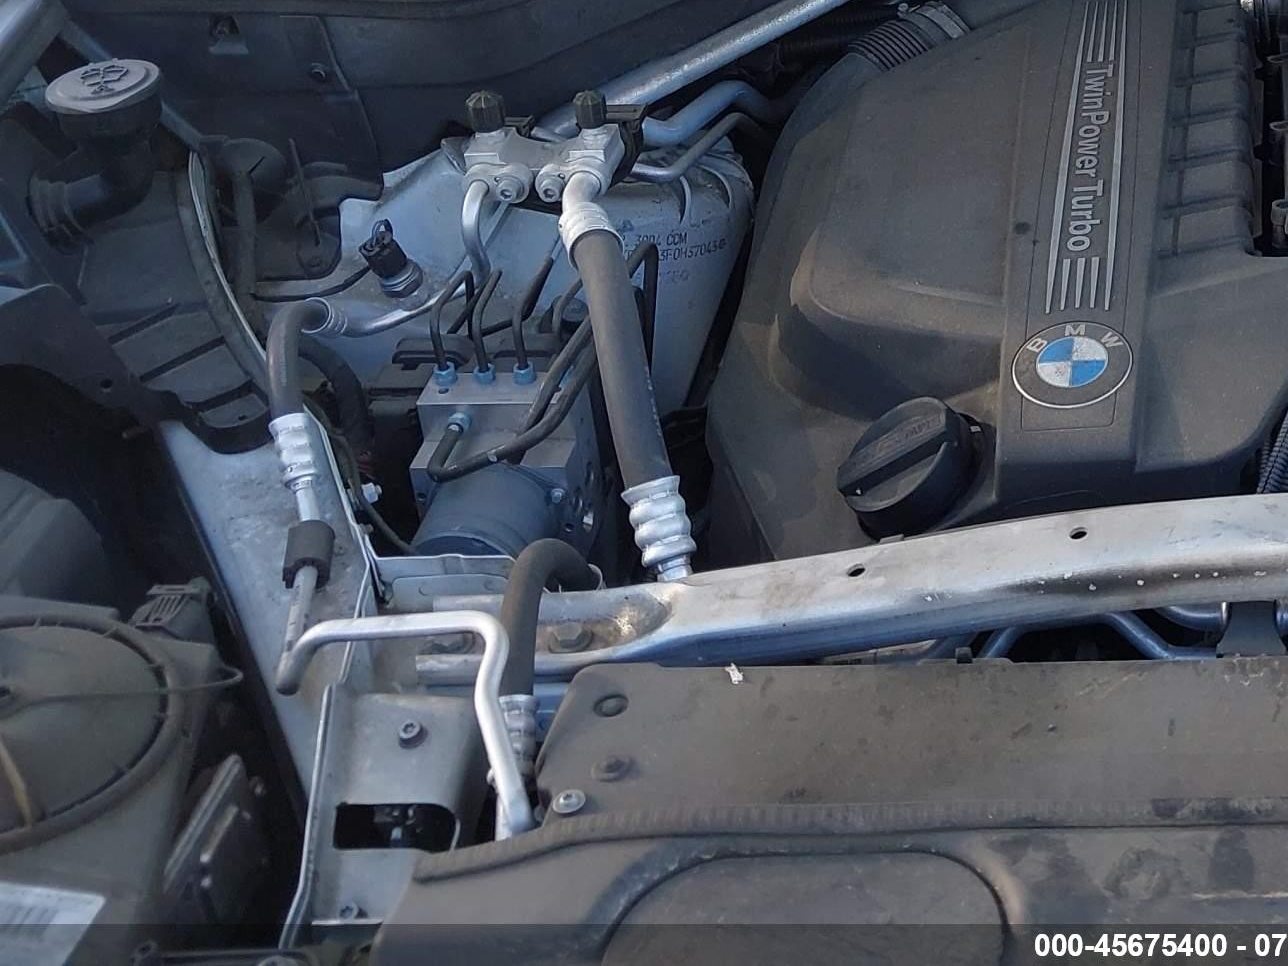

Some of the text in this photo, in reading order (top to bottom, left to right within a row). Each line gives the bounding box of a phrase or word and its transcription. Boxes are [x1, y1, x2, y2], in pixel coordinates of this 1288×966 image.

[1066, 63, 1114, 252] TwinPower Turbo
[666, 231, 688, 246] CCM
[1026, 323, 1124, 353] BMW
